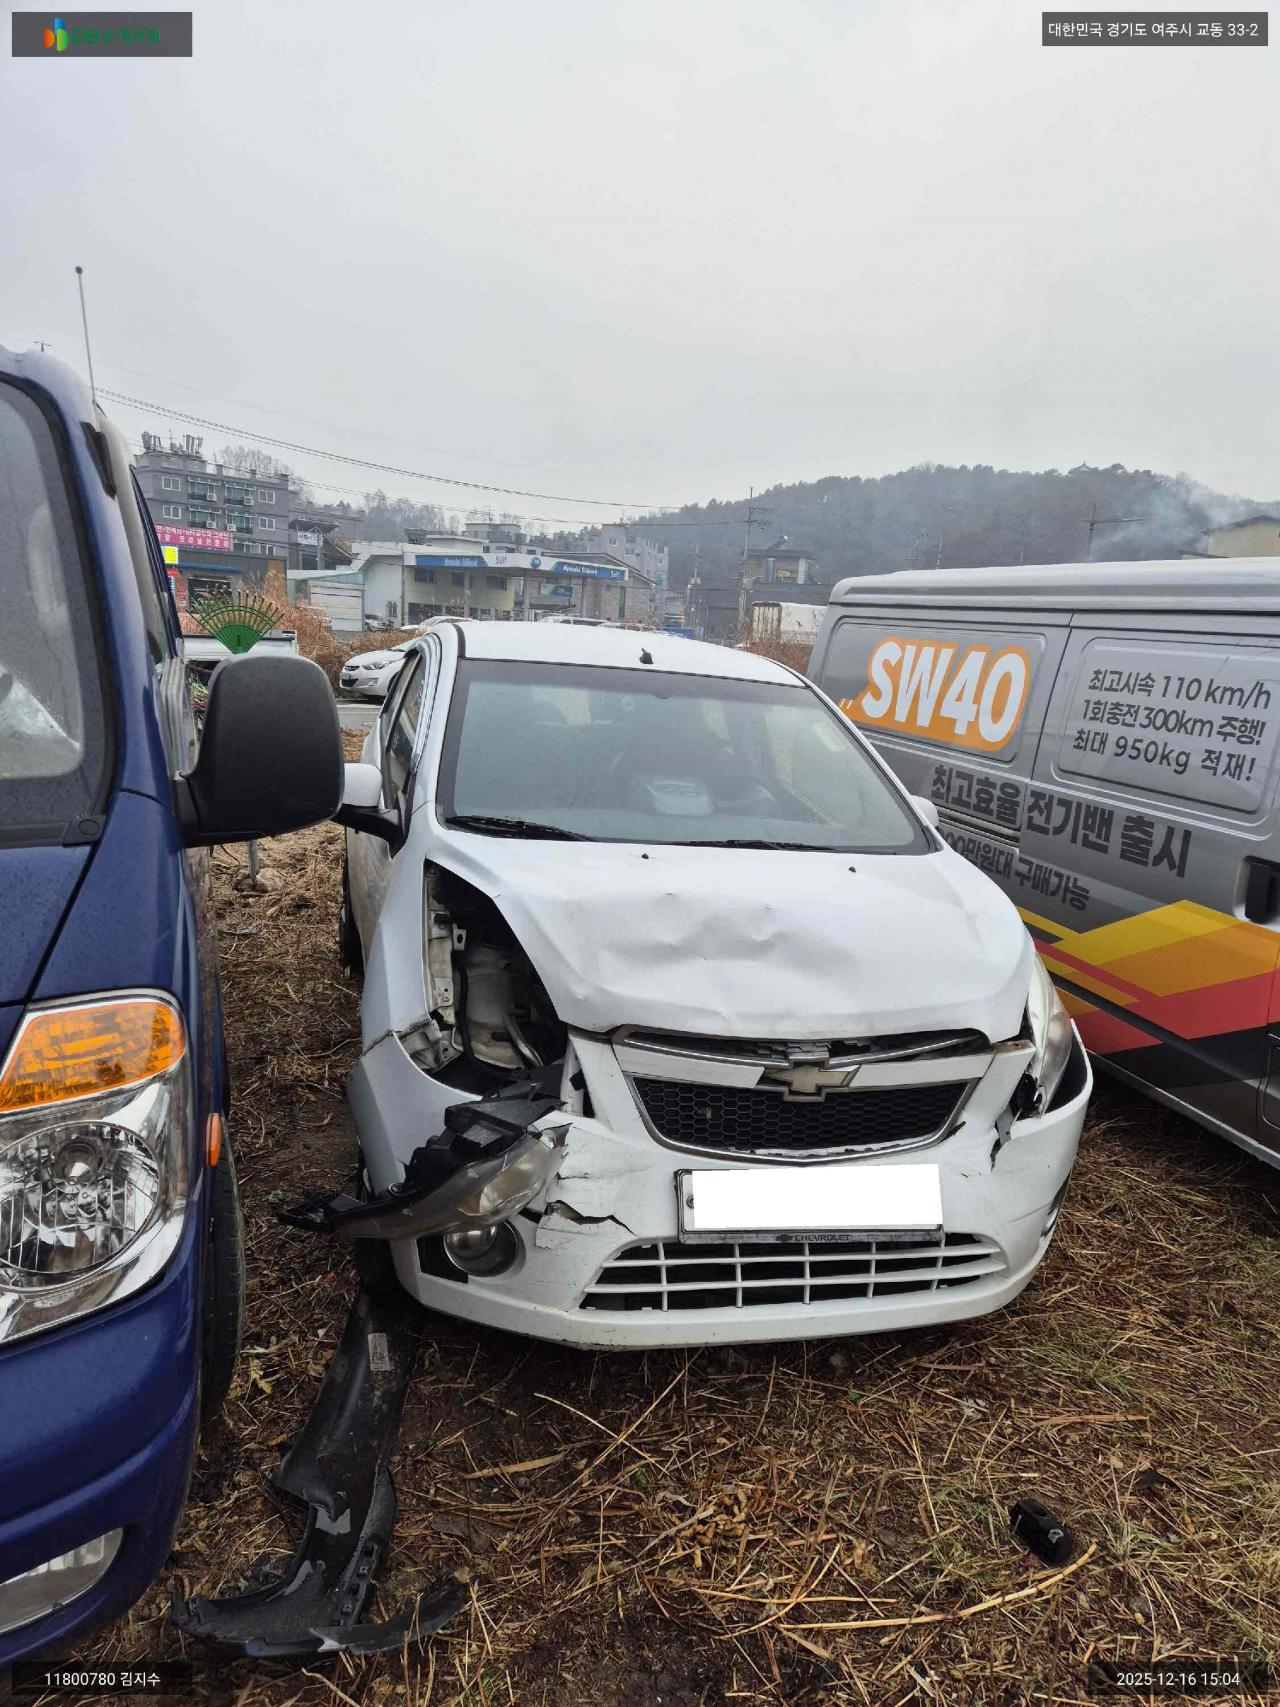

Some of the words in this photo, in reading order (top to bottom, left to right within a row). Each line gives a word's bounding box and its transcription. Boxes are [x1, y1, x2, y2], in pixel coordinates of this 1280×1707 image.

[861, 641, 1026, 743] SW40
[1088, 668, 1156, 697] 최고시속
[1073, 727, 1109, 756] 최대
[1114, 735, 1192, 775] 950kg
[1216, 715, 1266, 746] 주행!
[930, 764, 1021, 826] 최고효율
[1026, 788, 1115, 855] 전기밴
[1119, 814, 1192, 879] 출시
[1014, 855, 1090, 911] 구매가능
[795, 1233, 851, 1242] CHEVROLET
